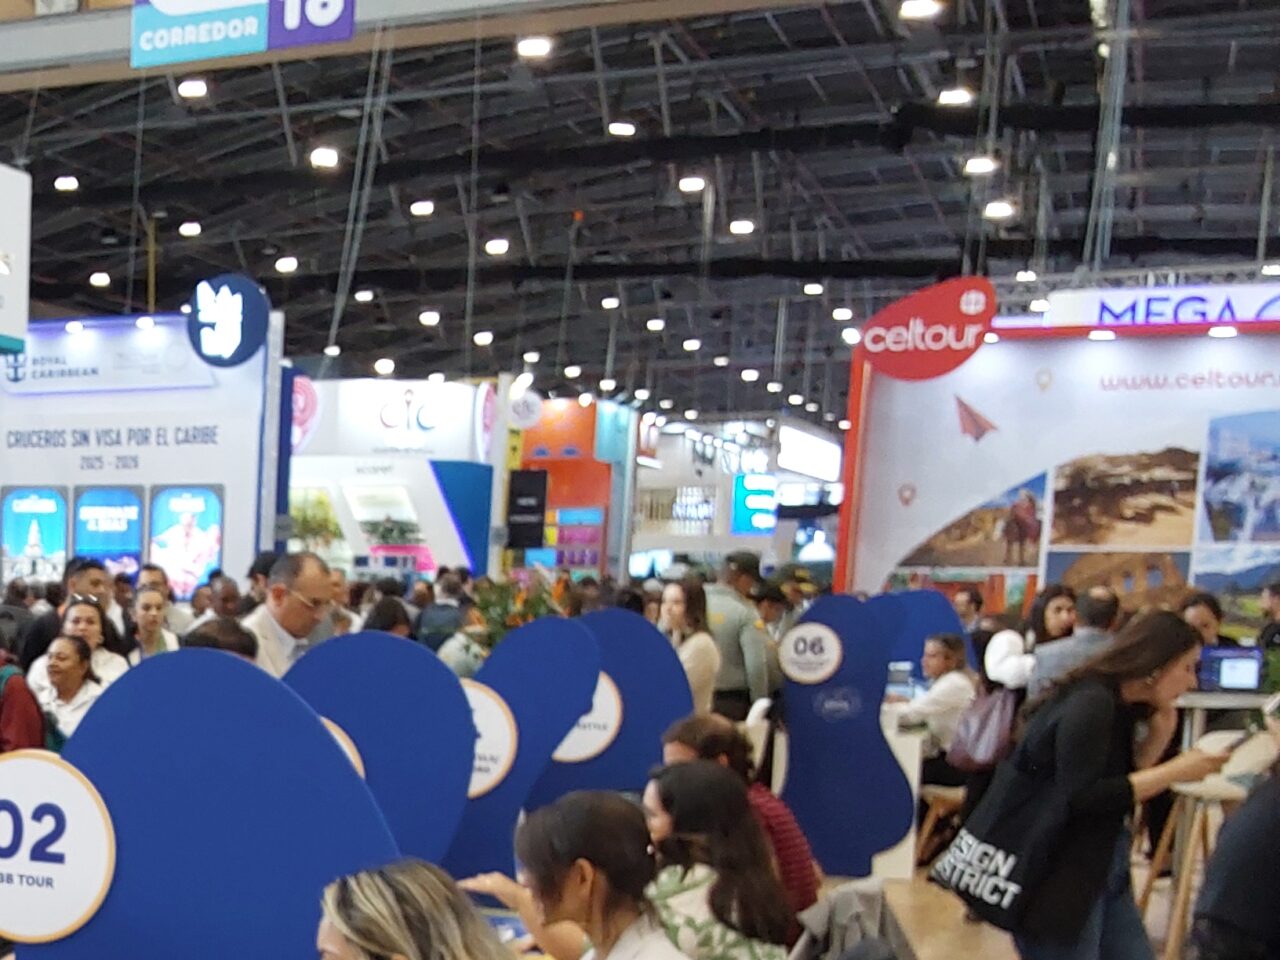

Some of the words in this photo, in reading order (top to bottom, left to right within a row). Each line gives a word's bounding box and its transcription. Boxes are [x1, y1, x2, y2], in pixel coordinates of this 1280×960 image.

[140, 16, 258, 50] CORREDOR
[863, 317, 984, 353] celtour
[32, 367, 99, 380] CARIBBEAN
[7, 429, 66, 449] CRUCEROS
[71, 429, 90, 448] SIN
[95, 428, 121, 447] VISA
[127, 428, 151, 446] POR
[156, 428, 169, 446] EL
[175, 425, 218, 446] CARIBE
[793, 636, 825, 656] 06
[17, 874, 55, 889] TOUR
